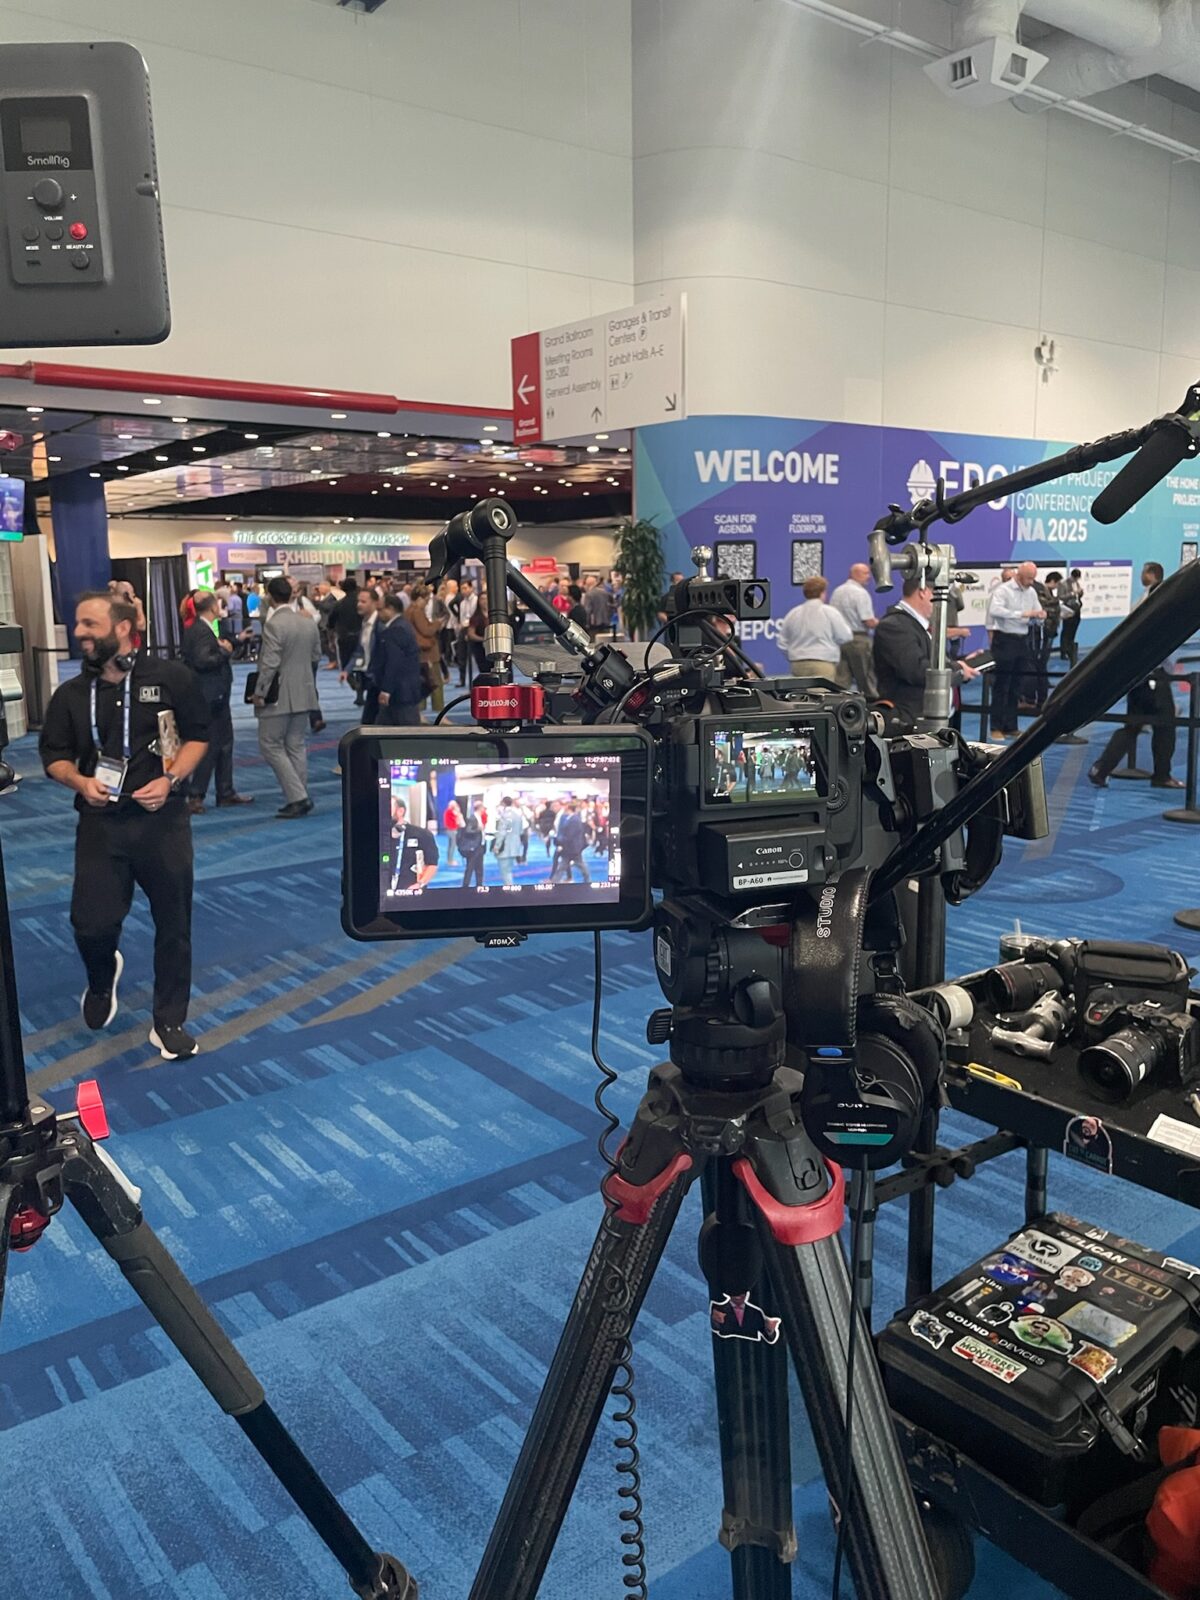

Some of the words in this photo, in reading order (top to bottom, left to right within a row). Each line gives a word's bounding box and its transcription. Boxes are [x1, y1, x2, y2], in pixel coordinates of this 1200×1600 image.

[27, 155, 70, 168] SmallRig
[608, 315, 640, 332] Garages
[649, 306, 672, 321] Transit
[544, 335, 565, 349] Grand
[565, 327, 594, 344] Ballroom
[608, 330, 637, 348] Centers
[544, 351, 571, 367] Meeting
[571, 347, 594, 358] Rooms
[608, 351, 632, 368] Exhibit
[632, 348, 649, 361] Halls
[545, 384, 570, 400] General
[571, 377, 601, 394] Assembly
[694, 449, 840, 485] WELCOME
[714, 514, 739, 525] SCAN
[740, 514, 757, 524] FOR
[718, 524, 754, 534] AGENDA
[791, 514, 810, 524] SCAN
[1016, 518, 1046, 542] NA
[1047, 518, 1088, 543] 2025
[276, 550, 354, 564] EXHIBITION
[358, 550, 392, 564] HALL
[755, 847, 782, 855] Canon
[738, 876, 764, 886] BP-A60
[816, 886, 837, 938] STUDIO
[1056, 1230, 1128, 1264] PELICAN
[1127, 1261, 1166, 1281] AIR
[1113, 1269, 1167, 1297] YETI
[945, 1310, 990, 1337] SOUND
[997, 1338, 1046, 1366] DEVICES
